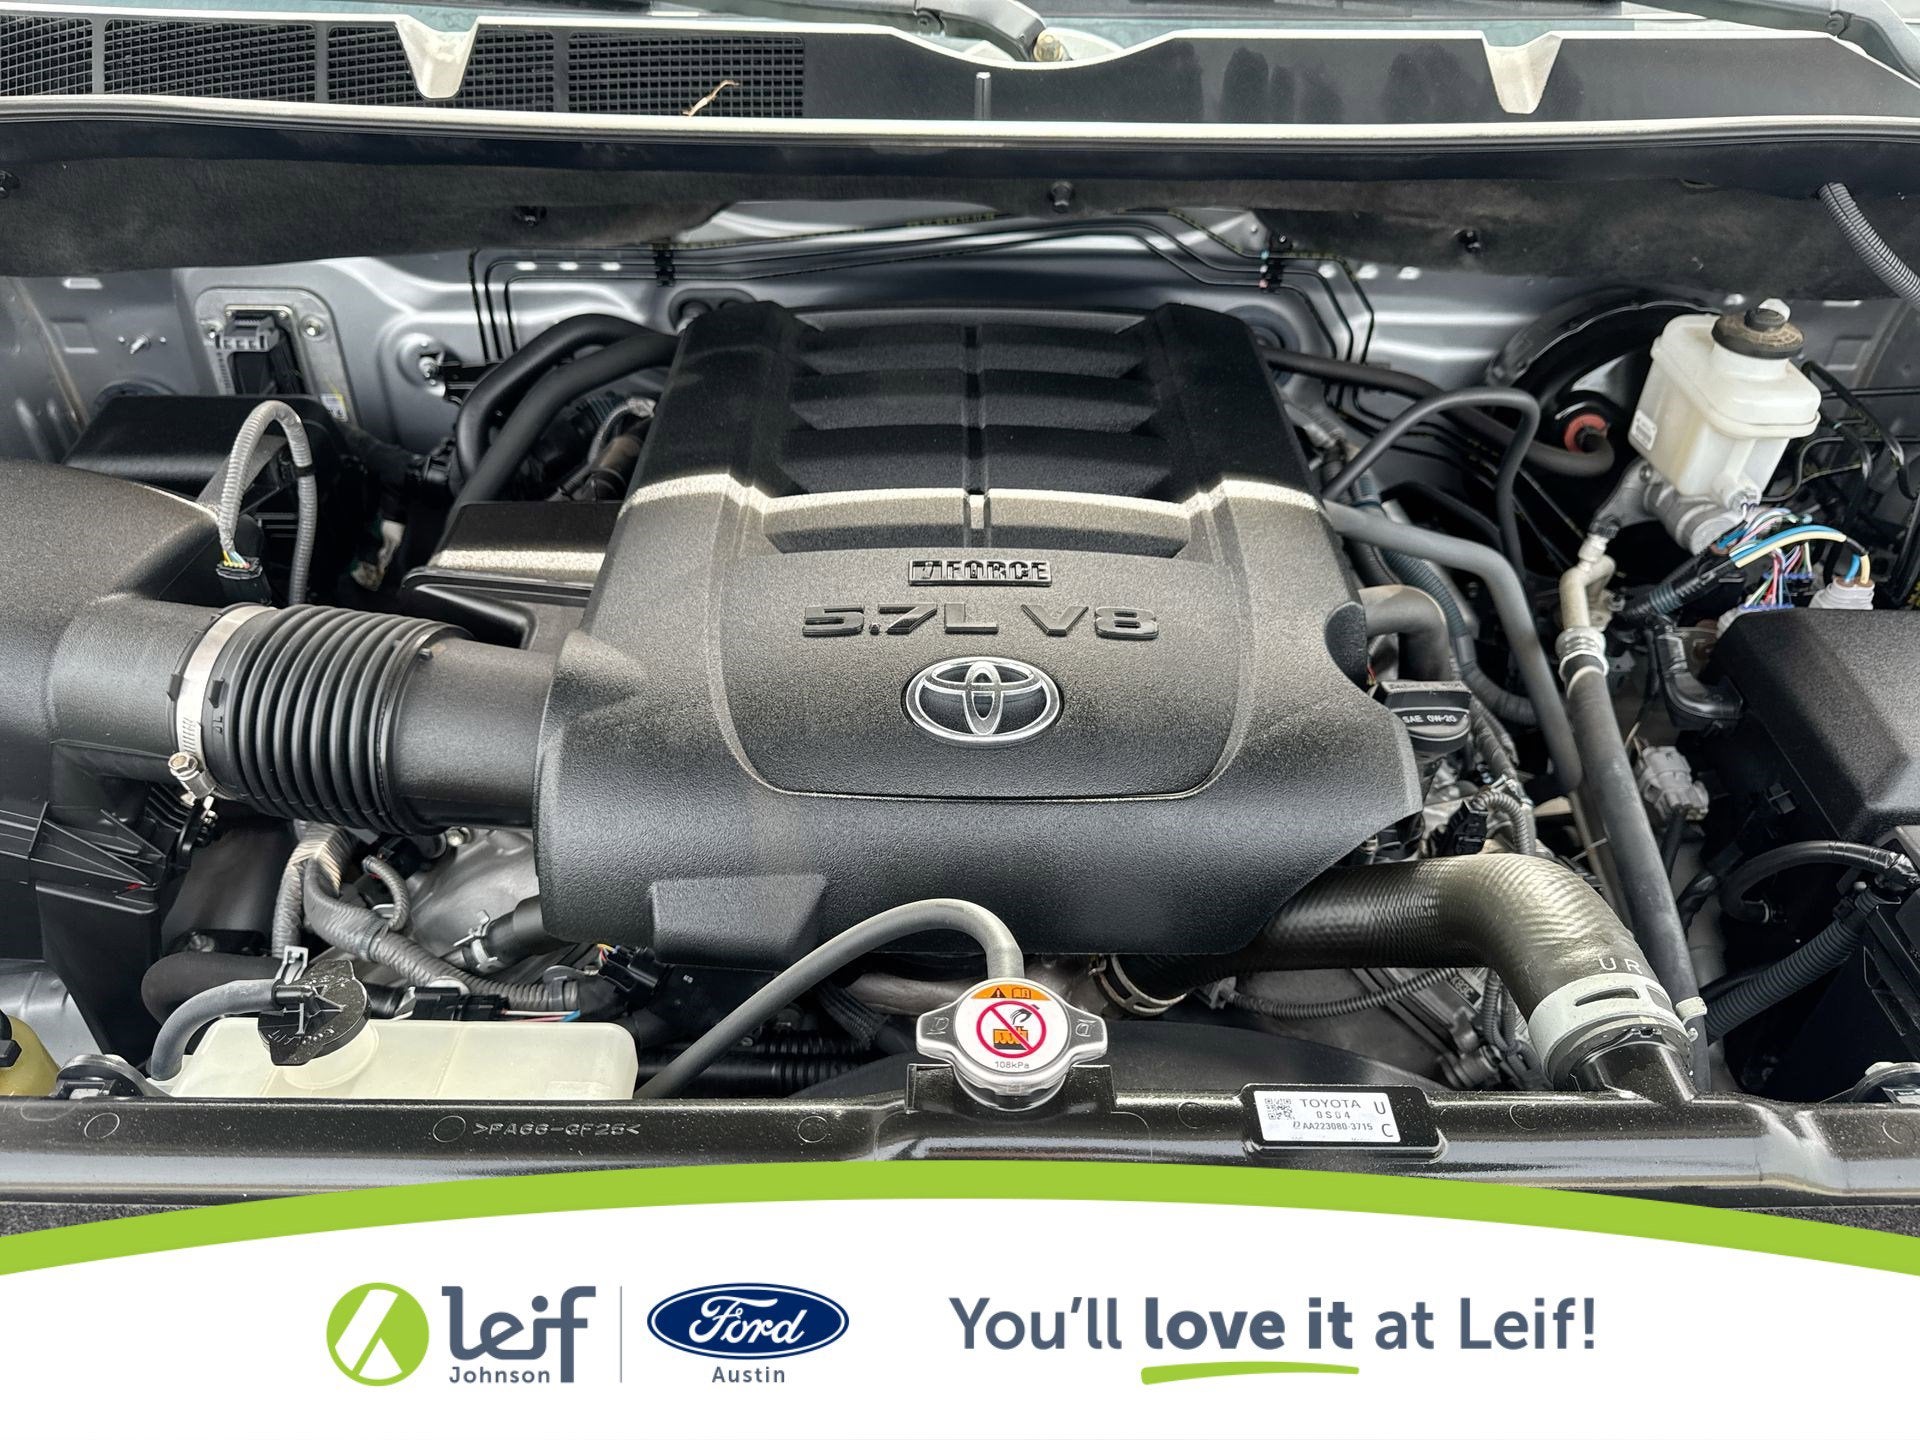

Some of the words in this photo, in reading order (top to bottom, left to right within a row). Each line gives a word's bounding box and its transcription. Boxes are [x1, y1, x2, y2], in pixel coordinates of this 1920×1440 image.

[802, 603, 999, 637] 5.7L
[1021, 605, 1160, 640] V8
[1402, 714, 1423, 724] SAE
[994, 1060, 1030, 1069] 108kPa
[1299, 1098, 1362, 1109] TOYOTA
[1373, 1101, 1387, 1115] U
[1381, 1123, 1394, 1138] C
